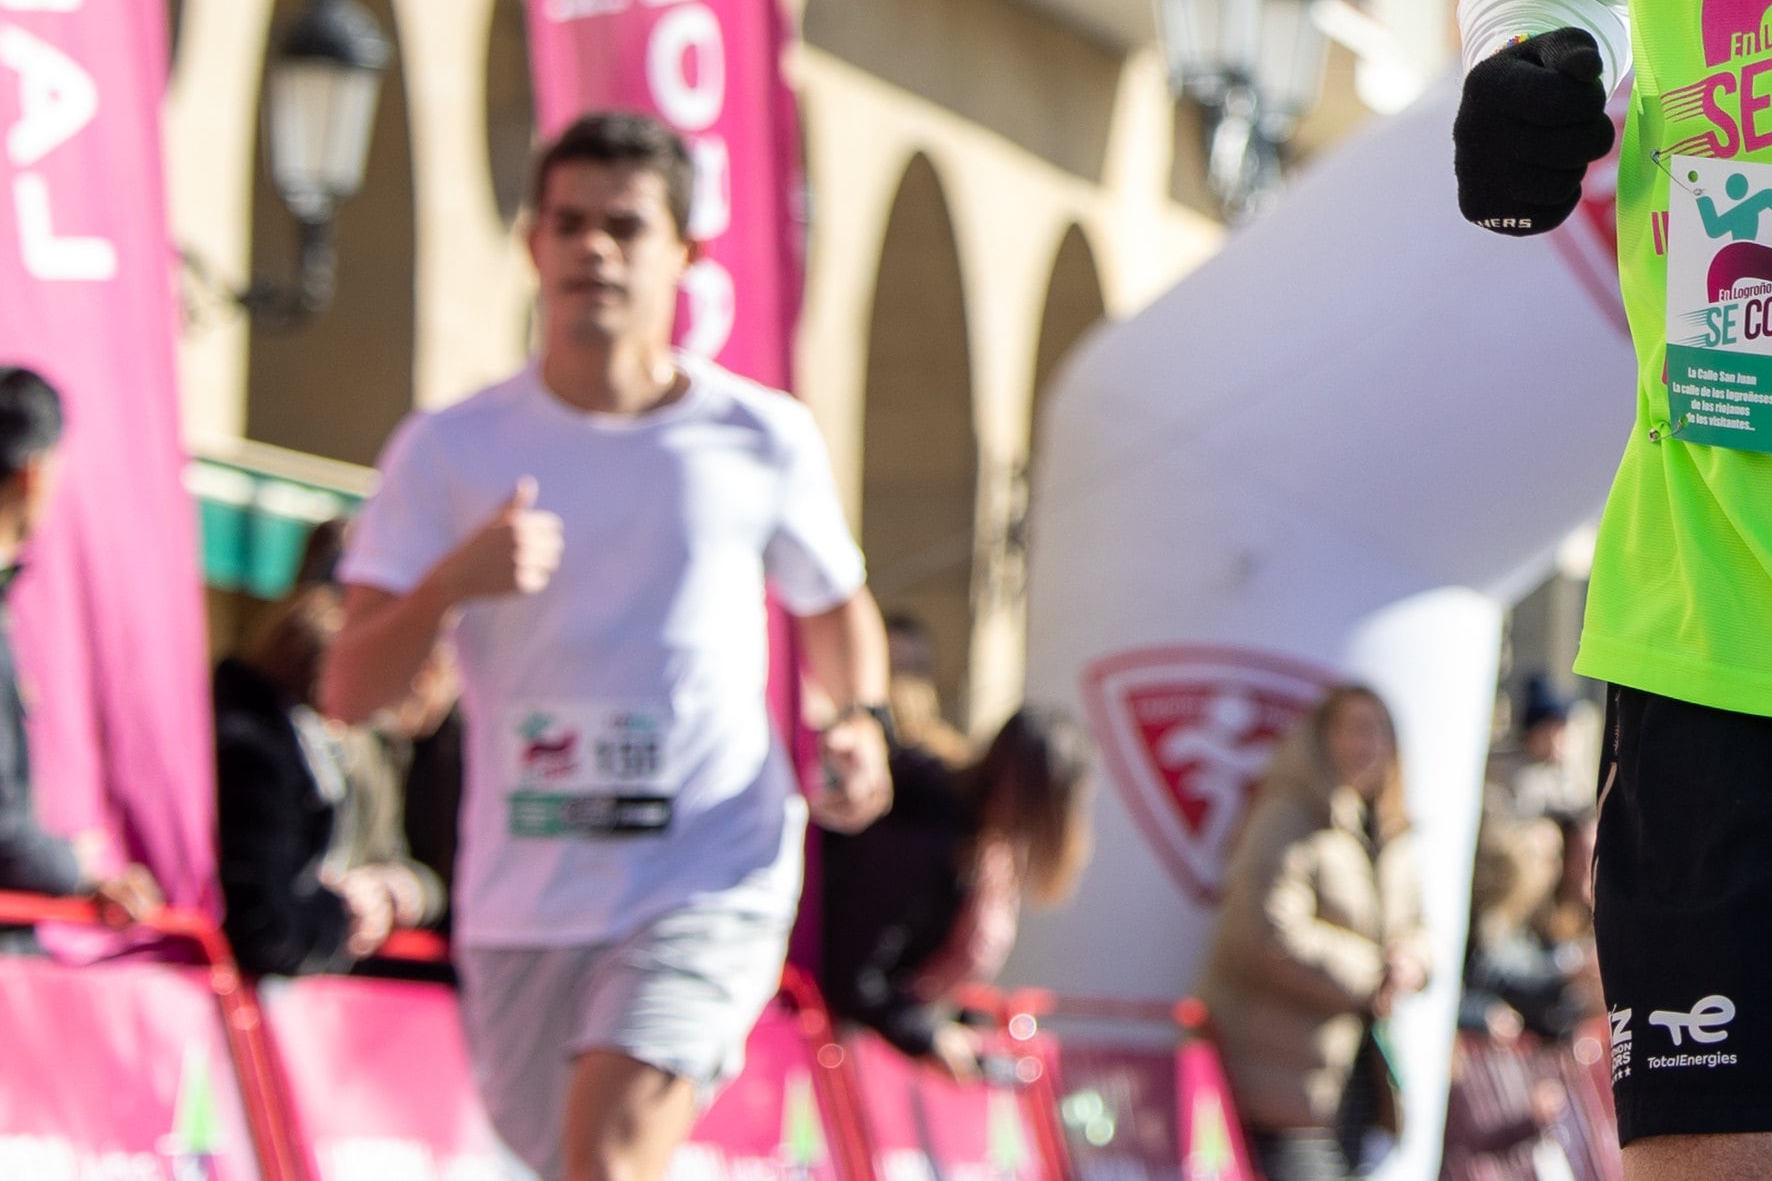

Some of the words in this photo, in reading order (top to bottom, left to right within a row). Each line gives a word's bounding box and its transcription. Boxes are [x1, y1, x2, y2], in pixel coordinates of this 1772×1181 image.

[1733, 29, 1757, 57] En
[1474, 218, 1532, 229] HERS
[1733, 282, 1772, 300] Logroño
[1699, 303, 1738, 348] SE
[1688, 367, 1697, 379] La
[1697, 368, 1718, 381] Calle
[1719, 370, 1735, 383] San
[1737, 372, 1757, 385] Juan
[1673, 382, 1681, 393] La
[1681, 383, 1699, 396] calle
[1701, 386, 1711, 397] de
[1691, 399, 1700, 410] de
[1715, 402, 1750, 416] riojanos
[1647, 1051, 1738, 1069] TotalEnergies
